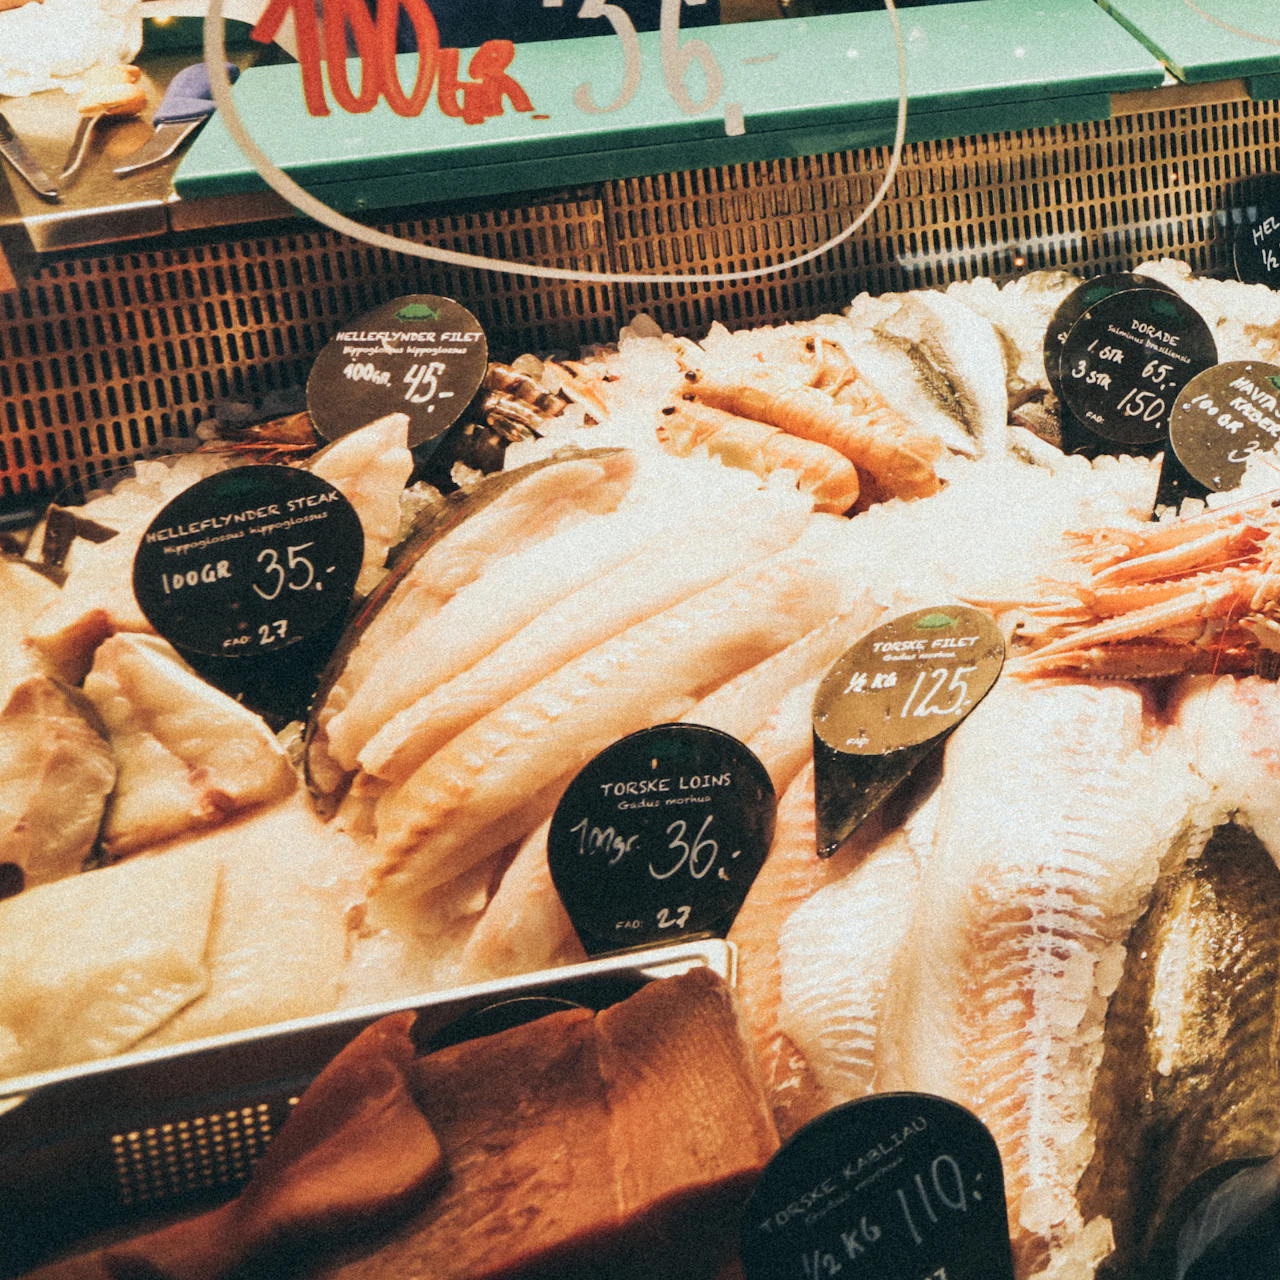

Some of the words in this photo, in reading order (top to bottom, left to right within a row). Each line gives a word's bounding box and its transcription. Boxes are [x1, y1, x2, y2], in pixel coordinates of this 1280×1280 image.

[335, 330, 437, 343] HELLEFLYNDER
[440, 331, 484, 343] FILET
[1130, 318, 1181, 347] DORADE
[1098, 345, 1126, 365] STK
[1070, 359, 1088, 379] 3
[1085, 370, 1113, 392] STK
[145, 503, 282, 544] HELLEFLYNDER
[286, 489, 340, 513] STEAK
[257, 619, 289, 646] 27
[872, 638, 929, 654] TORSKE
[930, 635, 981, 650] FILET
[600, 777, 672, 797] TORSKE
[679, 772, 732, 791] LOINS
[758, 1176, 838, 1234] TORSKE
